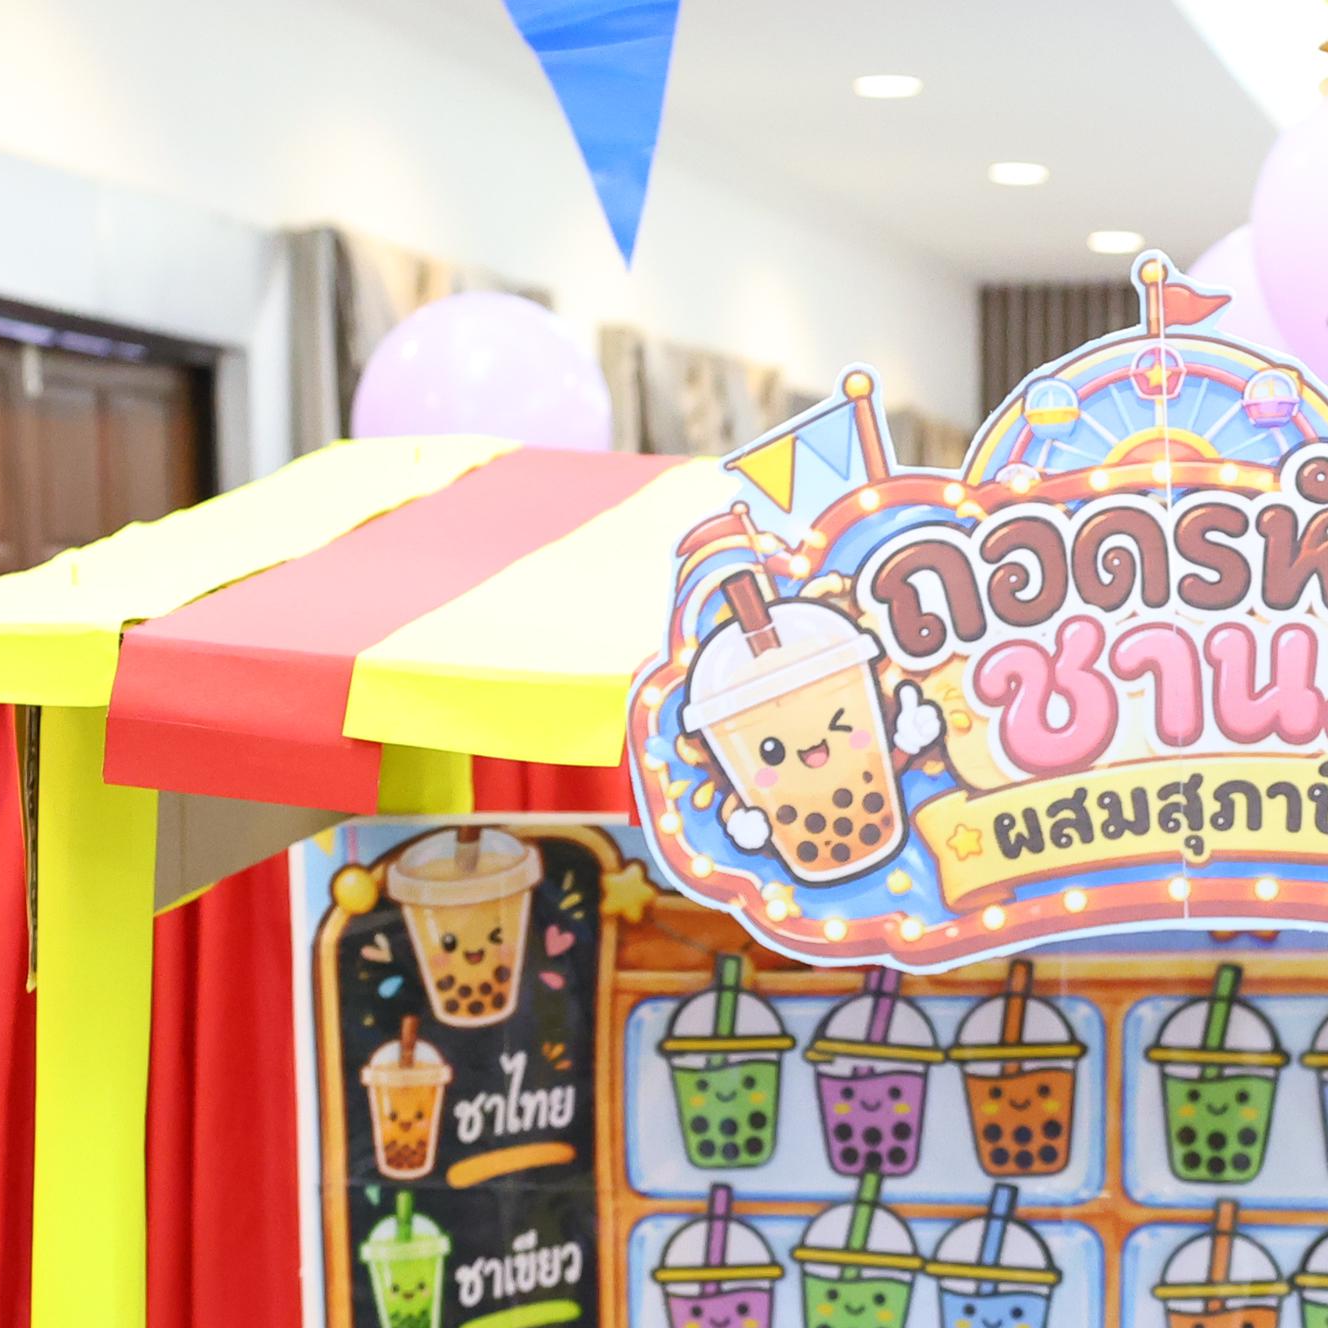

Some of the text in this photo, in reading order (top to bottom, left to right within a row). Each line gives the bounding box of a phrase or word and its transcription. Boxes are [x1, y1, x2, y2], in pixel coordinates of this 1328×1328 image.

[453, 1050, 576, 1144] ชาไทย
[454, 1229, 583, 1308] ชาเขียว
